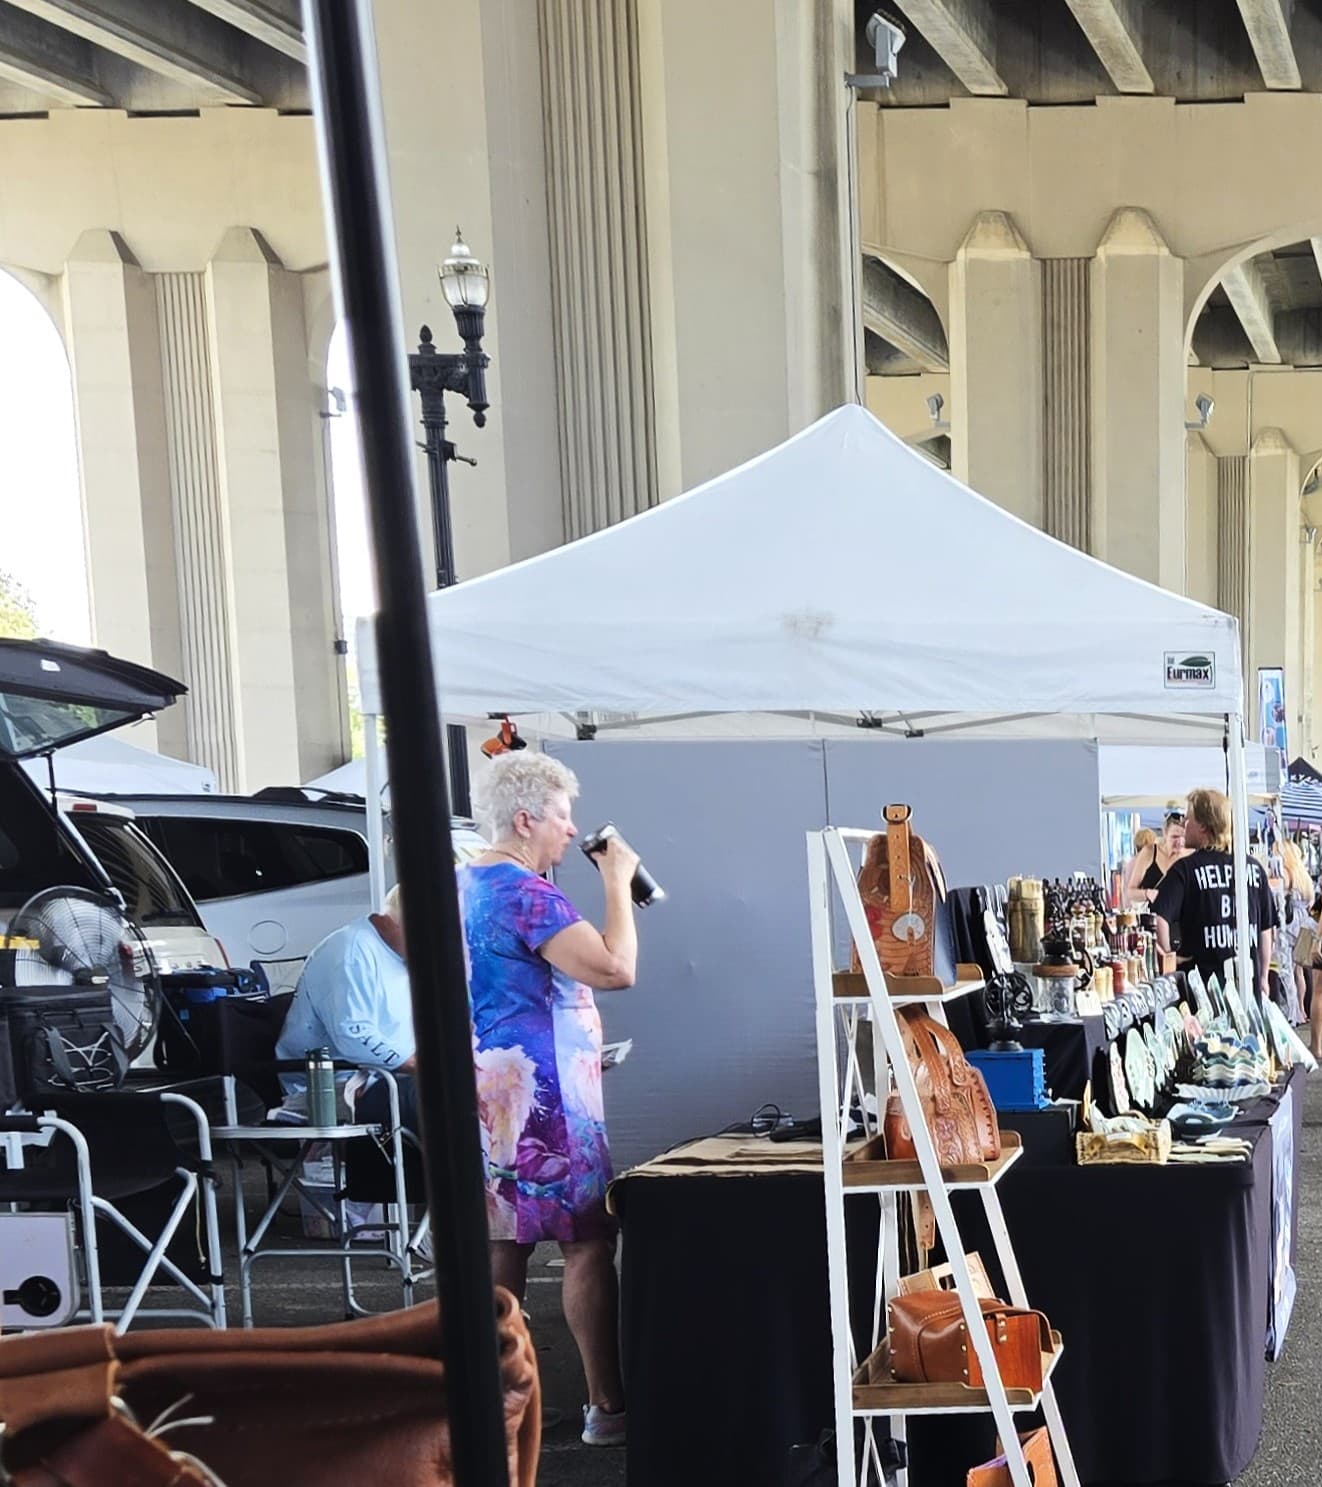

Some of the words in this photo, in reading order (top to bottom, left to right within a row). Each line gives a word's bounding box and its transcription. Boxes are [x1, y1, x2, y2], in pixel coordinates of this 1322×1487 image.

[1167, 666, 1209, 680] Eurmax
[1195, 864, 1233, 890] HELP
[1222, 895, 1236, 918] B
